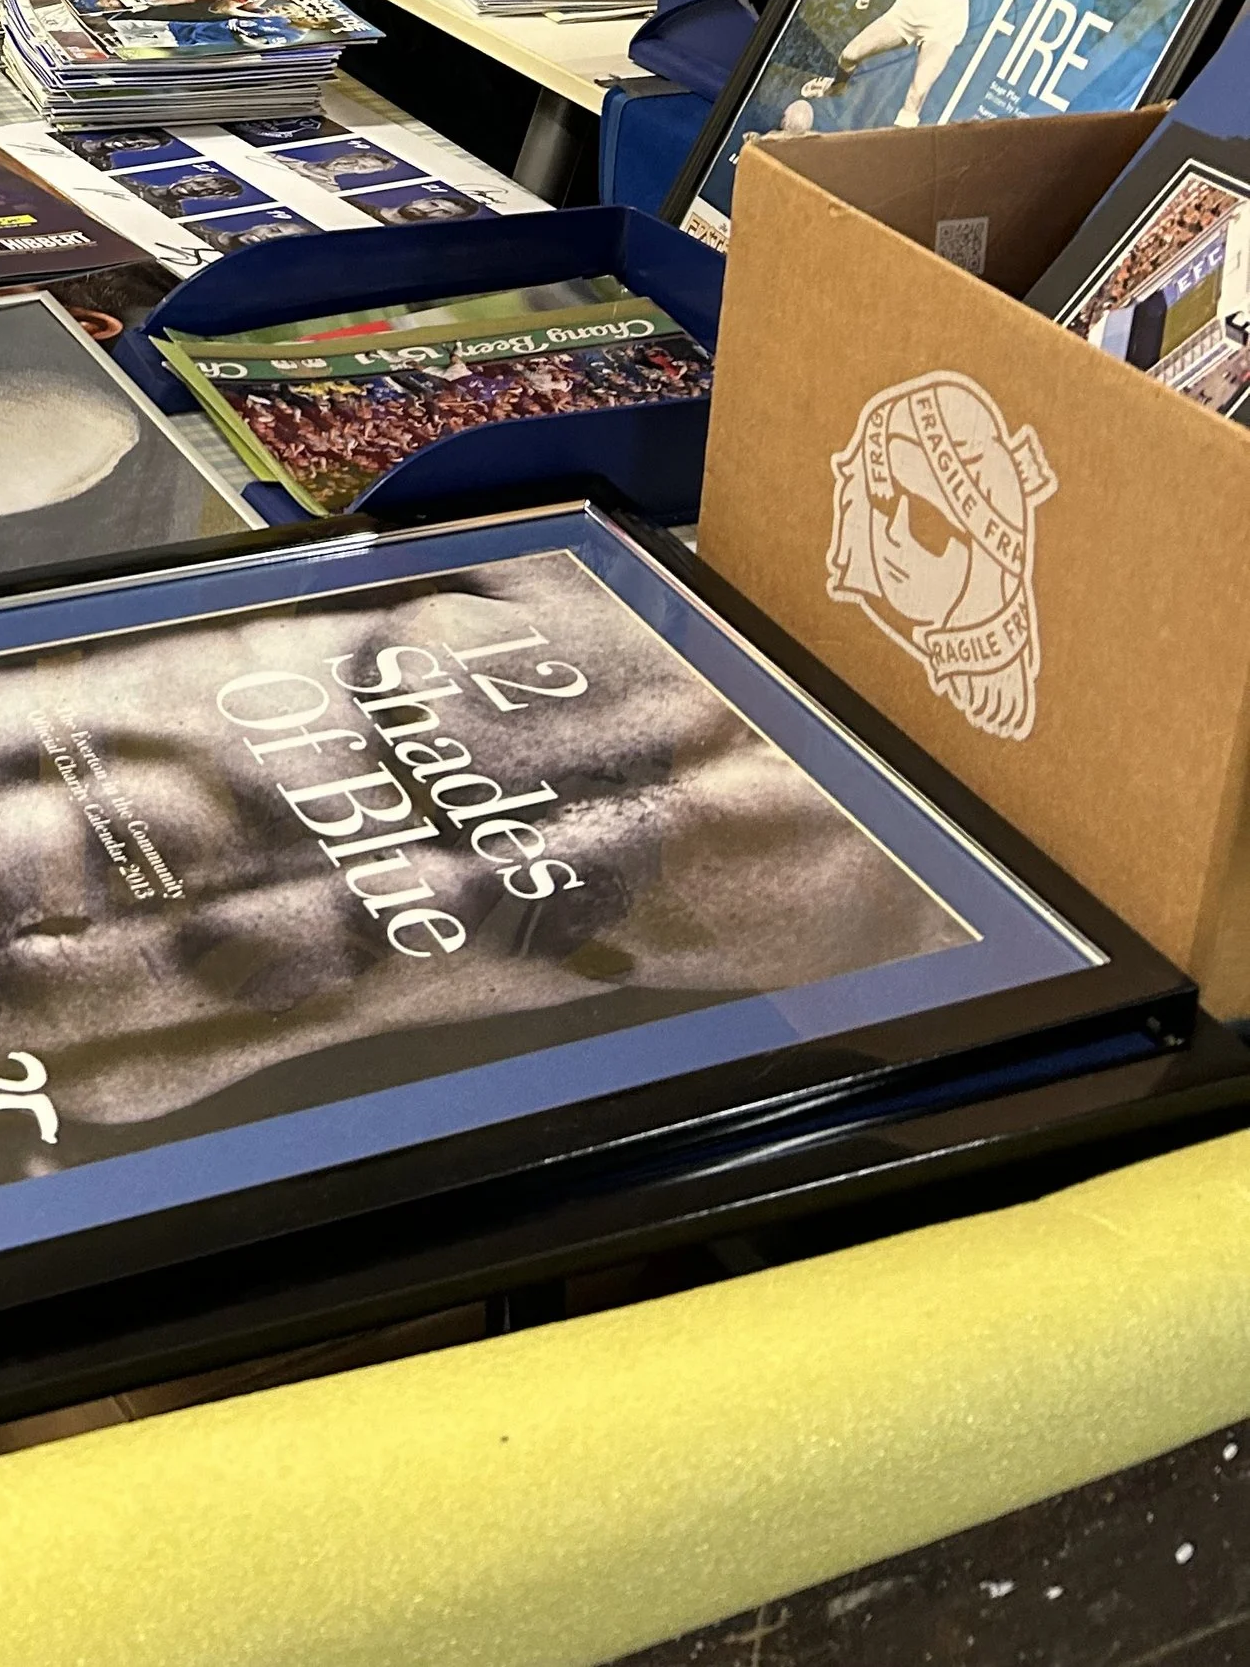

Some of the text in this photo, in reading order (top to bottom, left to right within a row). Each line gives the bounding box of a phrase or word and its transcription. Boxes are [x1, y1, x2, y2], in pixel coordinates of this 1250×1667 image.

[0, 231, 93, 253] HIBBERT
[1177, 242, 1224, 295] EFC
[547, 318, 656, 352] Chang
[916, 396, 978, 517] FRAGILE
[442, 625, 588, 712] 12
[28, 709, 155, 900] Official Charity Calendar 2013
[70, 730, 107, 781] Everton
[111, 795, 134, 820] the
[127, 819, 186, 900] Community
[216, 671, 467, 959] Of Blue
[323, 645, 585, 900] Shades
